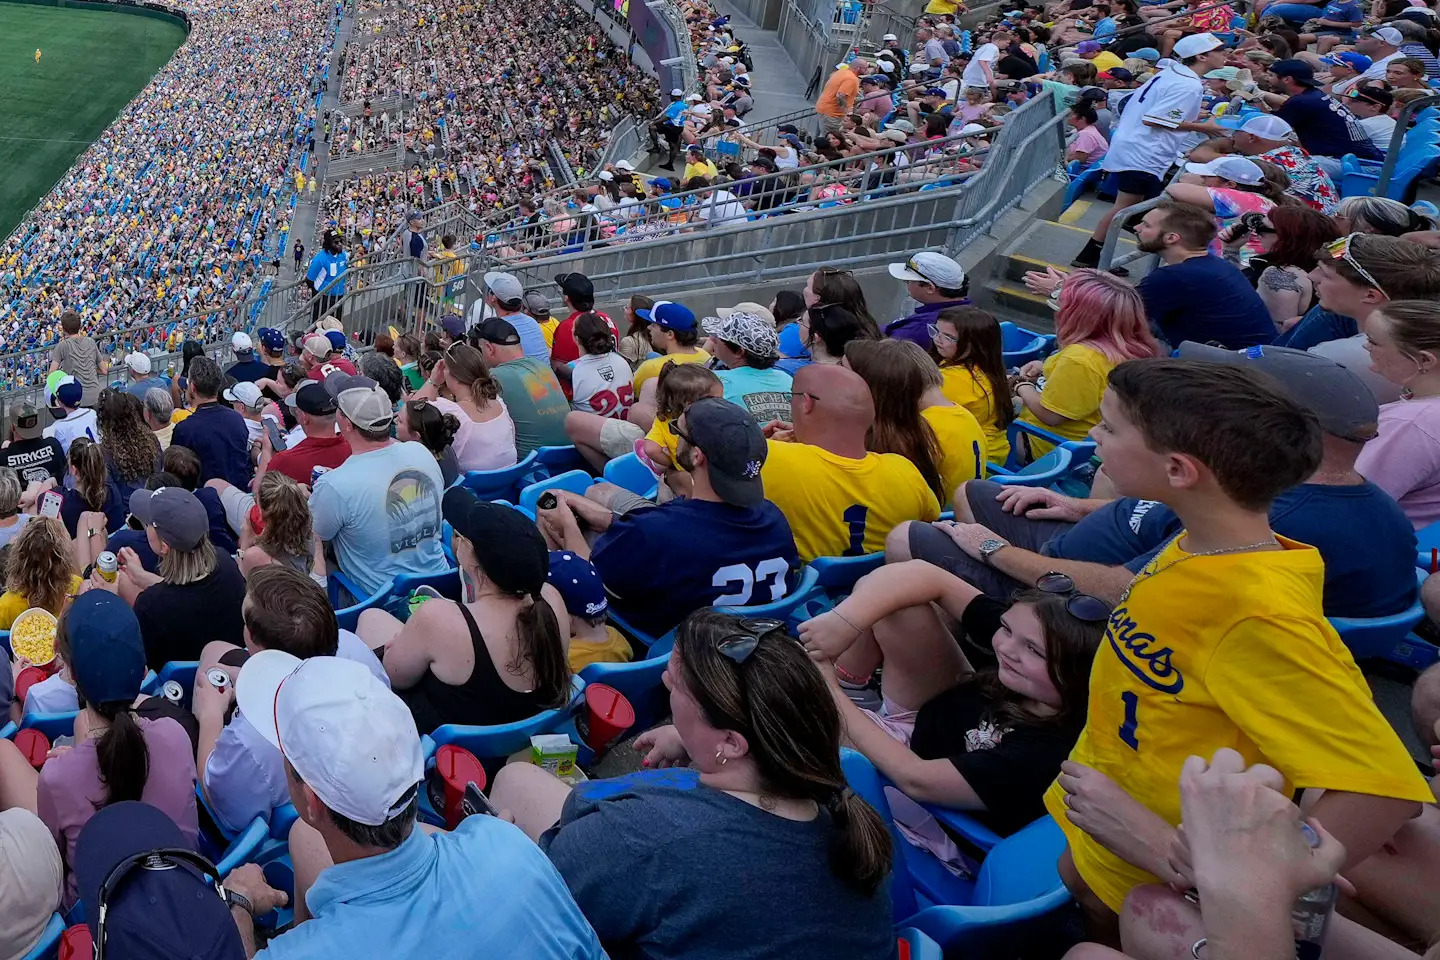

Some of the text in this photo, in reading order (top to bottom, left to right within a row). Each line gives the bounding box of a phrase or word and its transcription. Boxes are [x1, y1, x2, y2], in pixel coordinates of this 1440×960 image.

[7, 445, 55, 467] STRYKER
[841, 503, 868, 558] 1
[1108, 604, 1175, 681] anas
[1117, 690, 1140, 752] 1
